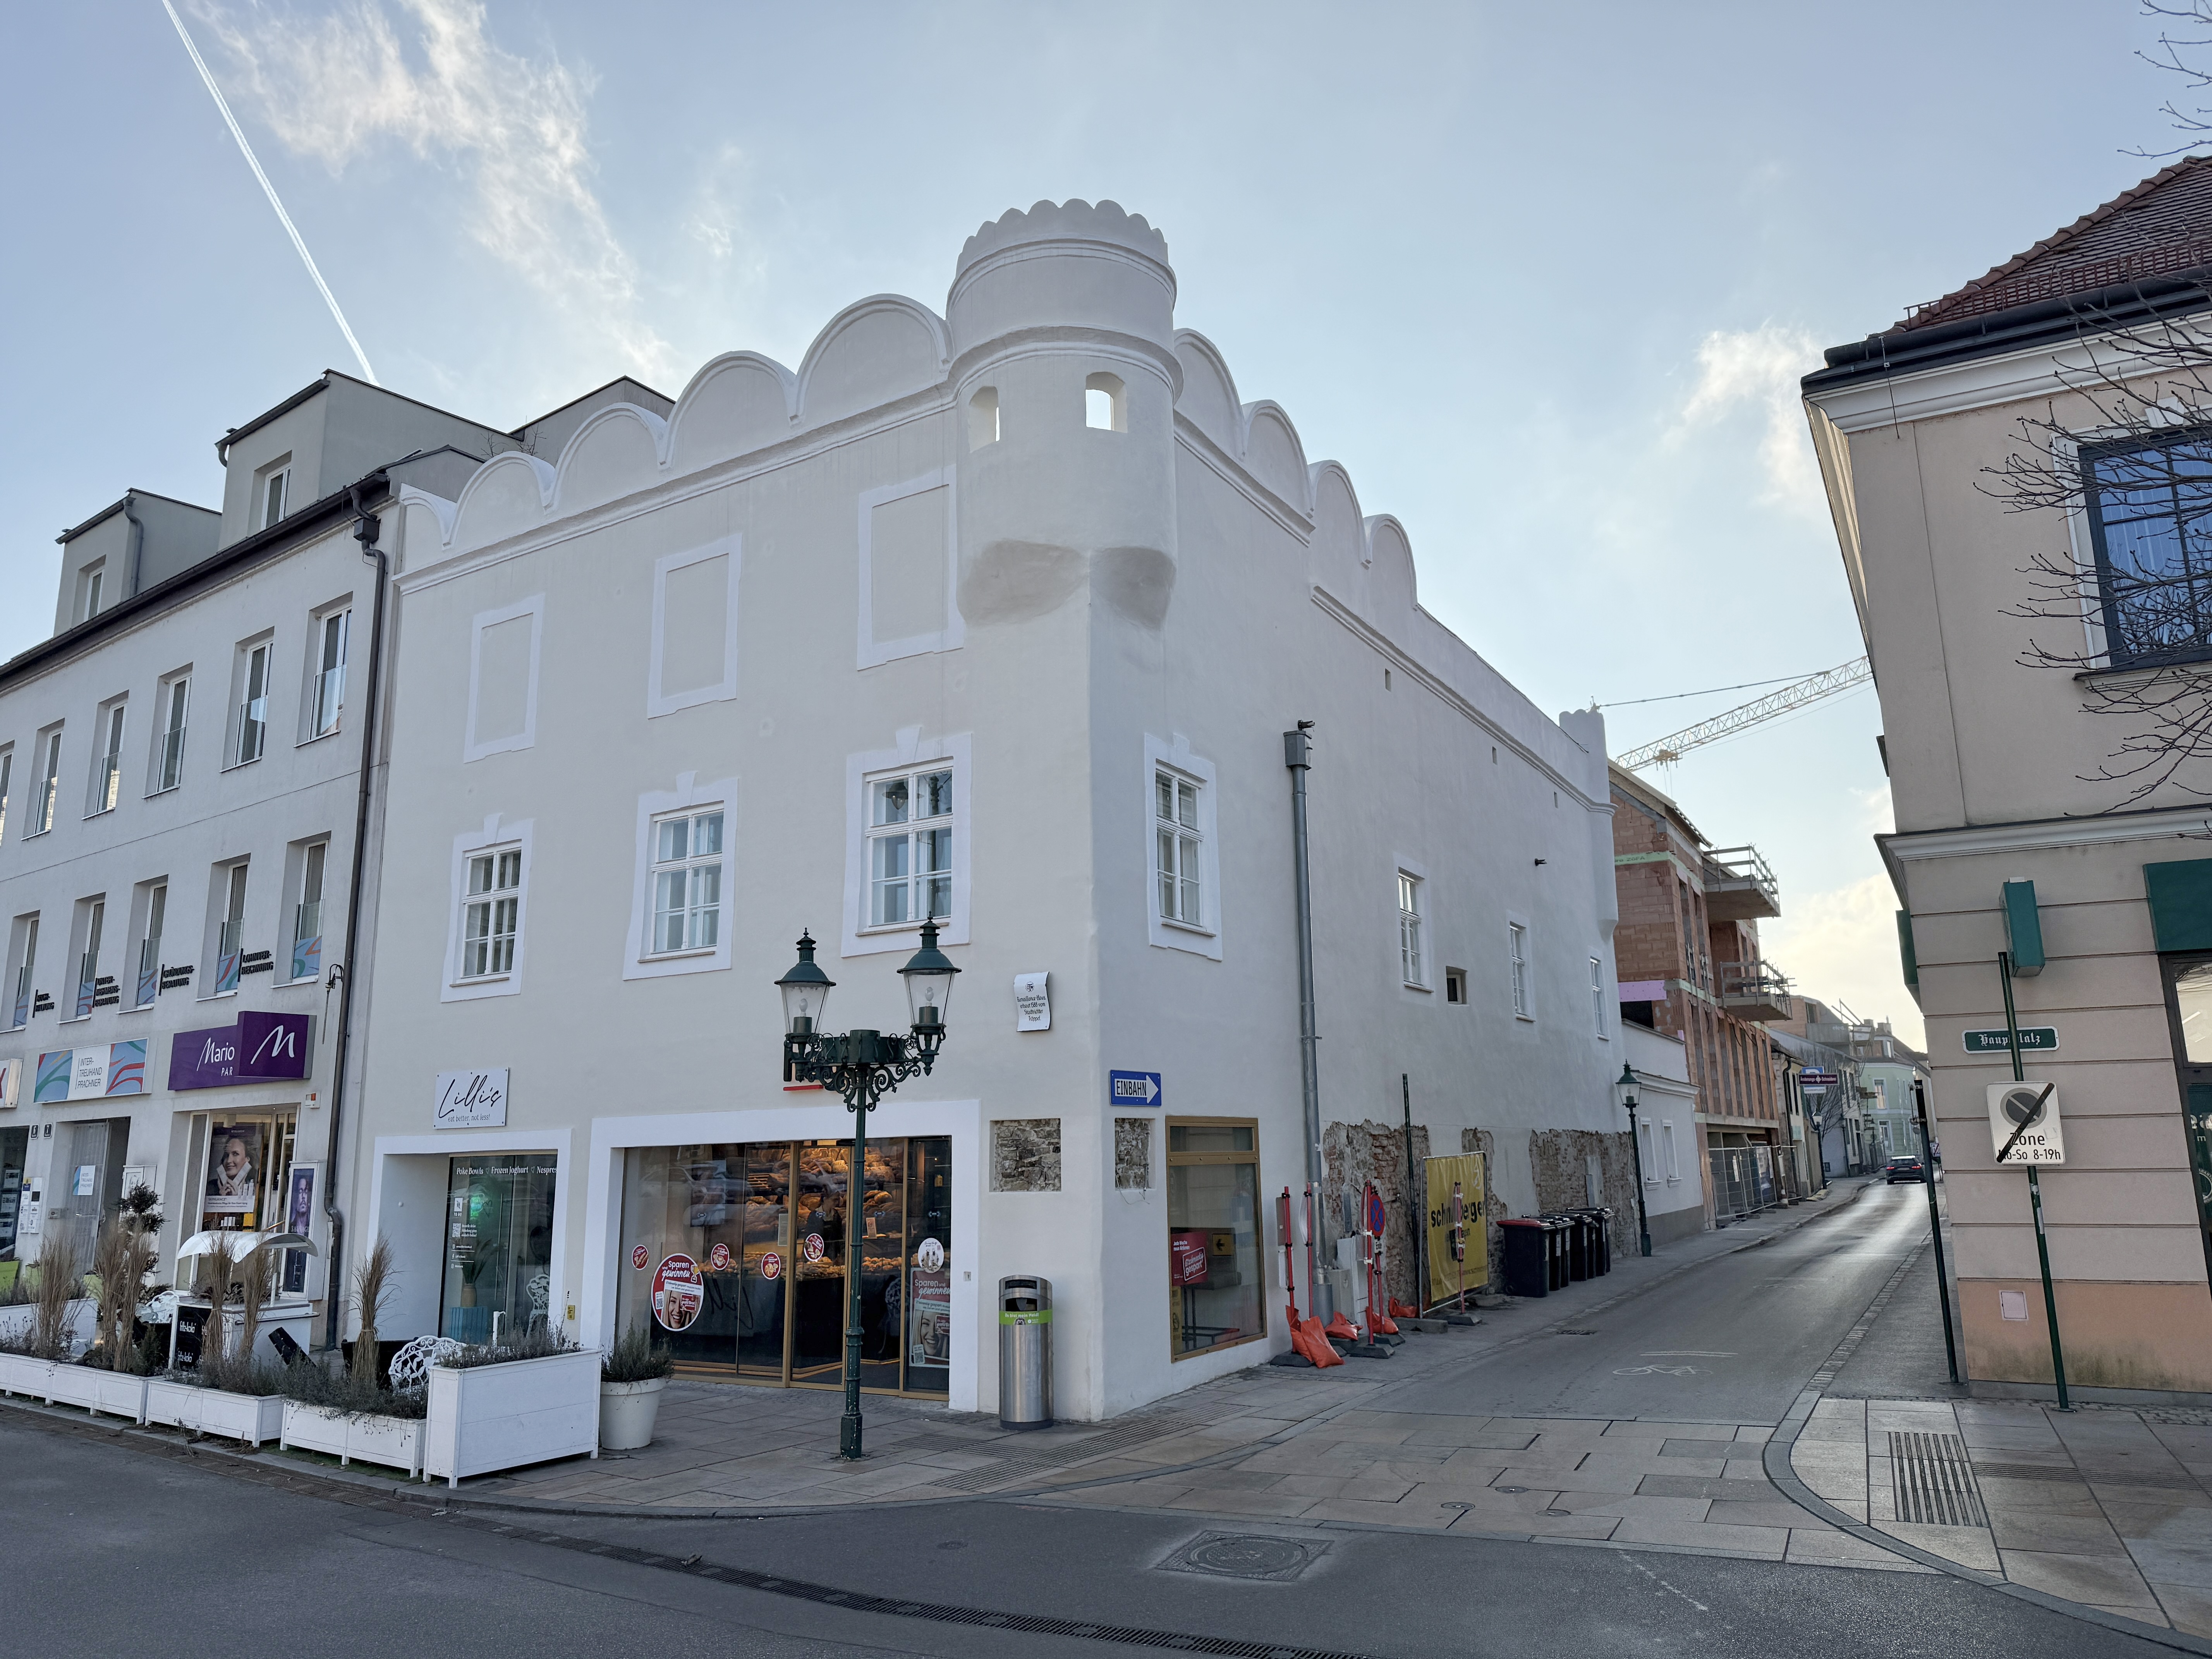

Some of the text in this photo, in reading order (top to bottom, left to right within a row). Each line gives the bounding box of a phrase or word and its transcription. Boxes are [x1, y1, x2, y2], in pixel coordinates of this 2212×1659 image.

[242, 950, 271, 963] LOHNVER-
[241, 962, 274, 975] RECHNUNG
[1978, 1032, 2040, 1046] Hauplatz
[196, 1037, 235, 1071] Mario
[81, 1058, 94, 1066] INTER-
[79, 1067, 102, 1077] TREUHAND
[77, 1079, 101, 1089] PRACHNER
[1116, 1080, 1146, 1096] EINBAHN
[438, 1075, 501, 1118] Lilli's
[2010, 1132, 2045, 1146] Zone
[1999, 1149, 2061, 1159] o-So 8-19h
[509, 1166, 528, 1175] Joghurt
[668, 1261, 689, 1269] Sparen
[661, 1268, 690, 1282] gewinnen
[915, 1279, 938, 1288] Sparen
[918, 1287, 950, 1300] gewinnen
[180, 1321, 196, 1333] fritz-kola
